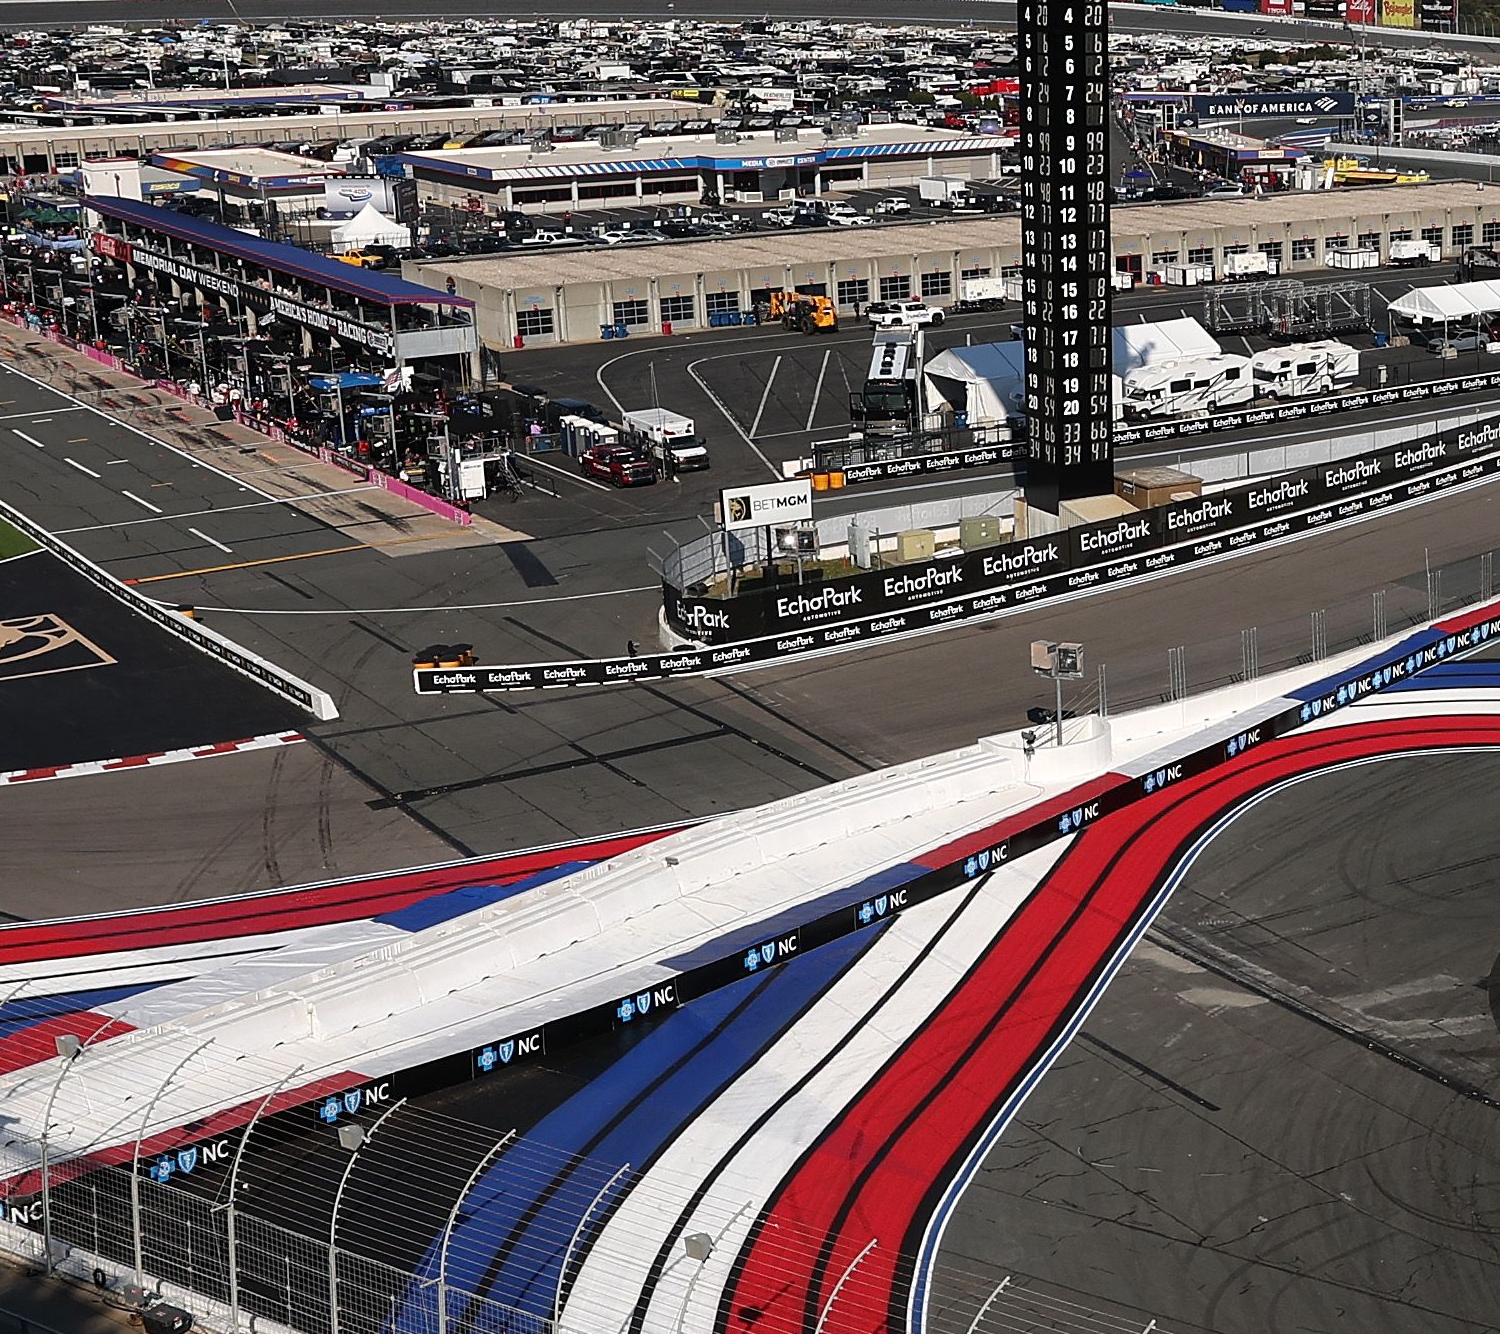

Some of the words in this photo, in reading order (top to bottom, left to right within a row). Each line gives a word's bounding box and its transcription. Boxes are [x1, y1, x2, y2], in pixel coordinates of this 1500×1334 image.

[1064, 8, 1074, 24] 4
[1064, 35, 1074, 51] 5
[1065, 58, 1075, 74] 6
[1065, 85, 1074, 101] 7
[1209, 104, 1241, 115] BANK
[1244, 104, 1258, 114] OF
[1261, 102, 1313, 113] AMERICA
[1066, 109, 1075, 125] 8
[1066, 135, 1075, 151] 9
[1059, 158, 1076, 174] 10
[1059, 185, 1075, 201] 11
[1060, 207, 1077, 223] 12
[1061, 234, 1077, 250] 13
[1061, 256, 1077, 272] 14
[133, 249, 180, 276] MEMORIAL
[180, 265, 198, 284] DAY
[198, 271, 239, 298] WEEKEND
[1061, 282, 1078, 298] 15
[1062, 304, 1078, 320] 16
[270, 296, 308, 323] AMERICA'S
[307, 309, 330, 331] HOME
[337, 320, 367, 345] RACING
[1062, 330, 1078, 346] 17
[1063, 352, 1079, 368] 18
[1063, 378, 1079, 394] 19
[1094, 374, 1107, 392] 14
[1064, 400, 1080, 416] 20
[1090, 395, 1107, 415] 54
[1064, 423, 1081, 444] 33
[1091, 421, 1107, 440] 66
[1065, 445, 1081, 465] 34
[1091, 441, 1108, 460] 41
[1394, 441, 1446, 468] EchoPark
[1325, 459, 1381, 488] EchoPark
[1248, 479, 1308, 509] EchoPark
[753, 494, 808, 512] BETMGM
[1168, 499, 1232, 530] EchoPark
[1080, 519, 1151, 552] EchoPark
[983, 543, 1059, 576] EchoPark
[884, 564, 963, 597] EchoPark
[777, 584, 862, 618] EchoPark
[712, 648, 750, 662] EchoPark
[606, 662, 648, 675] EchoPark
[434, 673, 476, 684] EchoPark
[1359, 677, 1372, 693] NC
[1248, 729, 1261, 744] NC
[1167, 765, 1183, 780] NC
[991, 845, 1009, 863] NC
[778, 936, 799, 956] NC
[655, 986, 675, 1005] NC
[518, 1032, 541, 1056] NC
[365, 1082, 391, 1106] NC
[202, 1139, 230, 1165] NC
